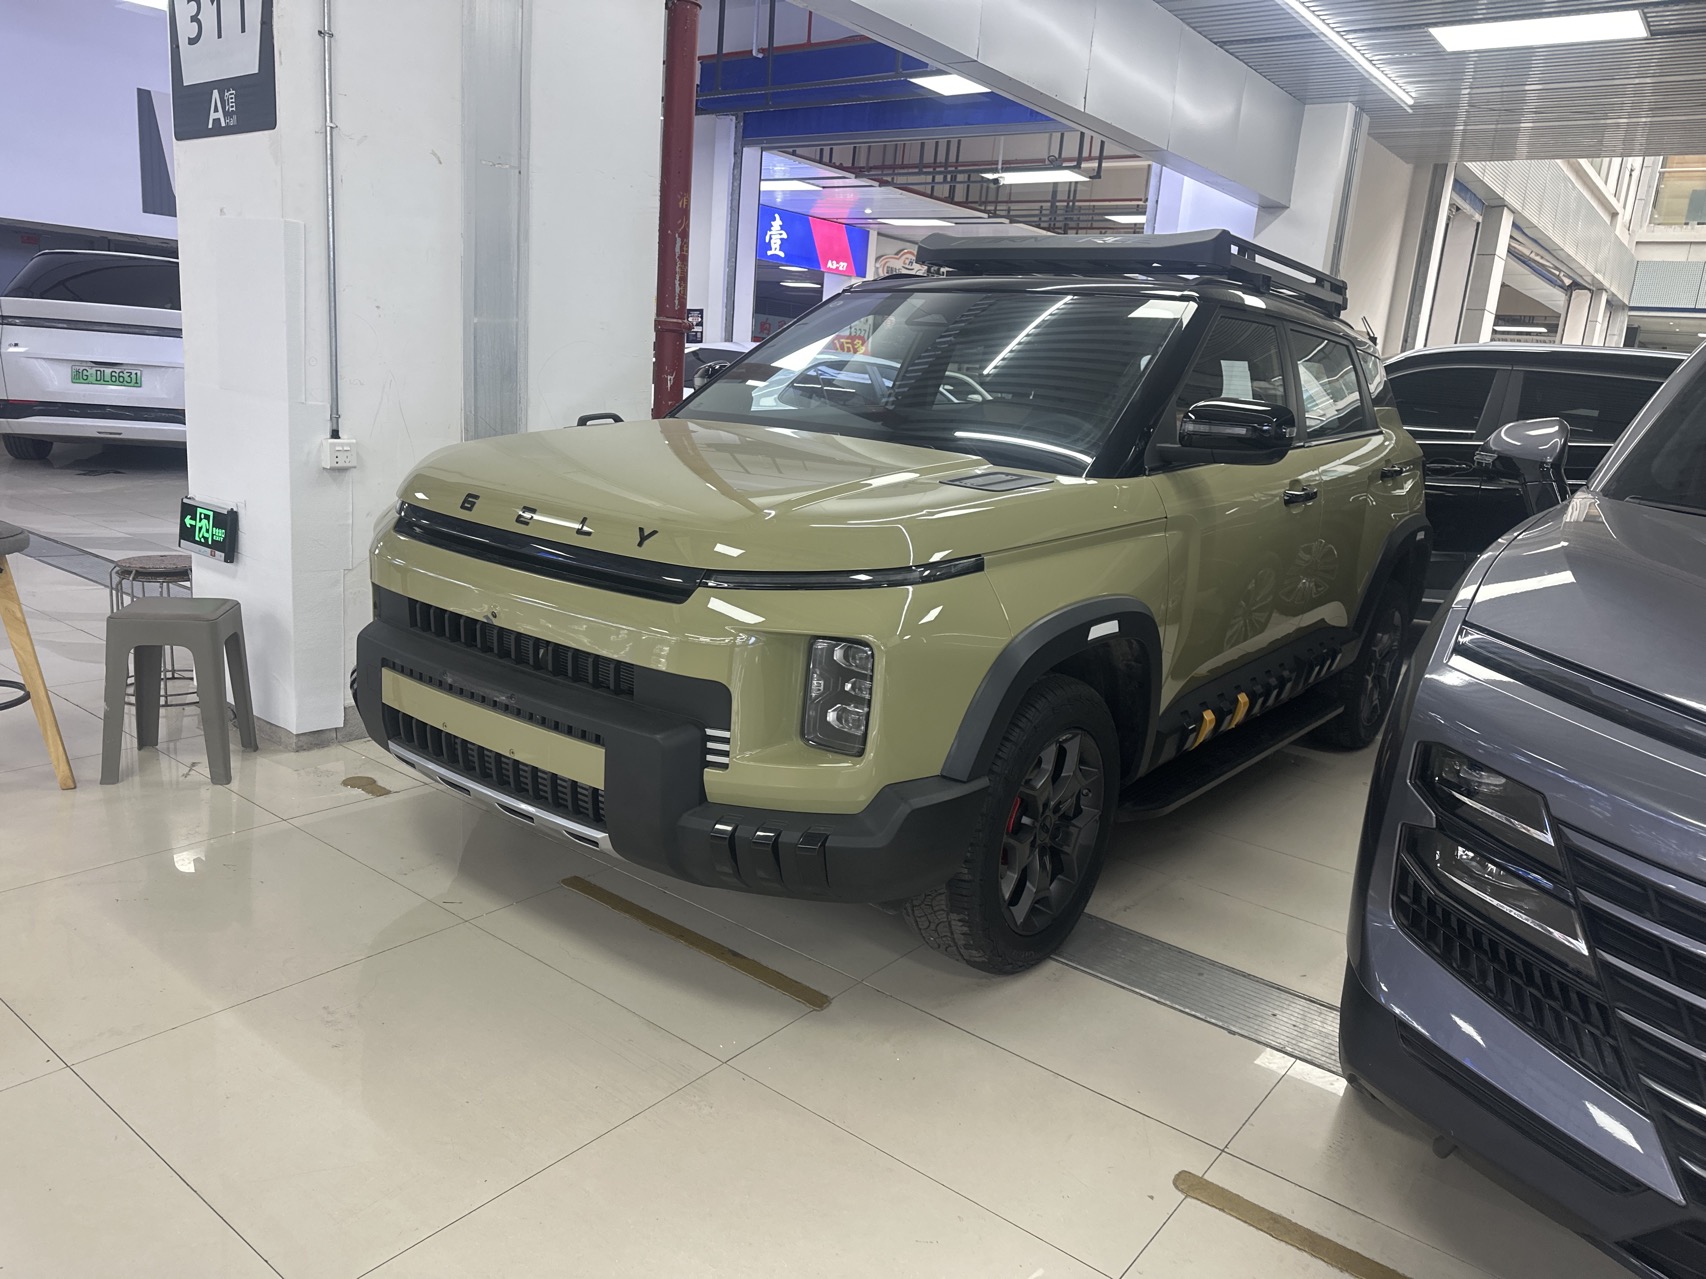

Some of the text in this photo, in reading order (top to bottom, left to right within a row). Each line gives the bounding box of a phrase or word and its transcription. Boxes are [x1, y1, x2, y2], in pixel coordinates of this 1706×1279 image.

[225, 115, 237, 126] Hall
[765, 213, 788, 258] 壹
[826, 259, 848, 271] A3-27
[95, 369, 139, 385] DL6631
